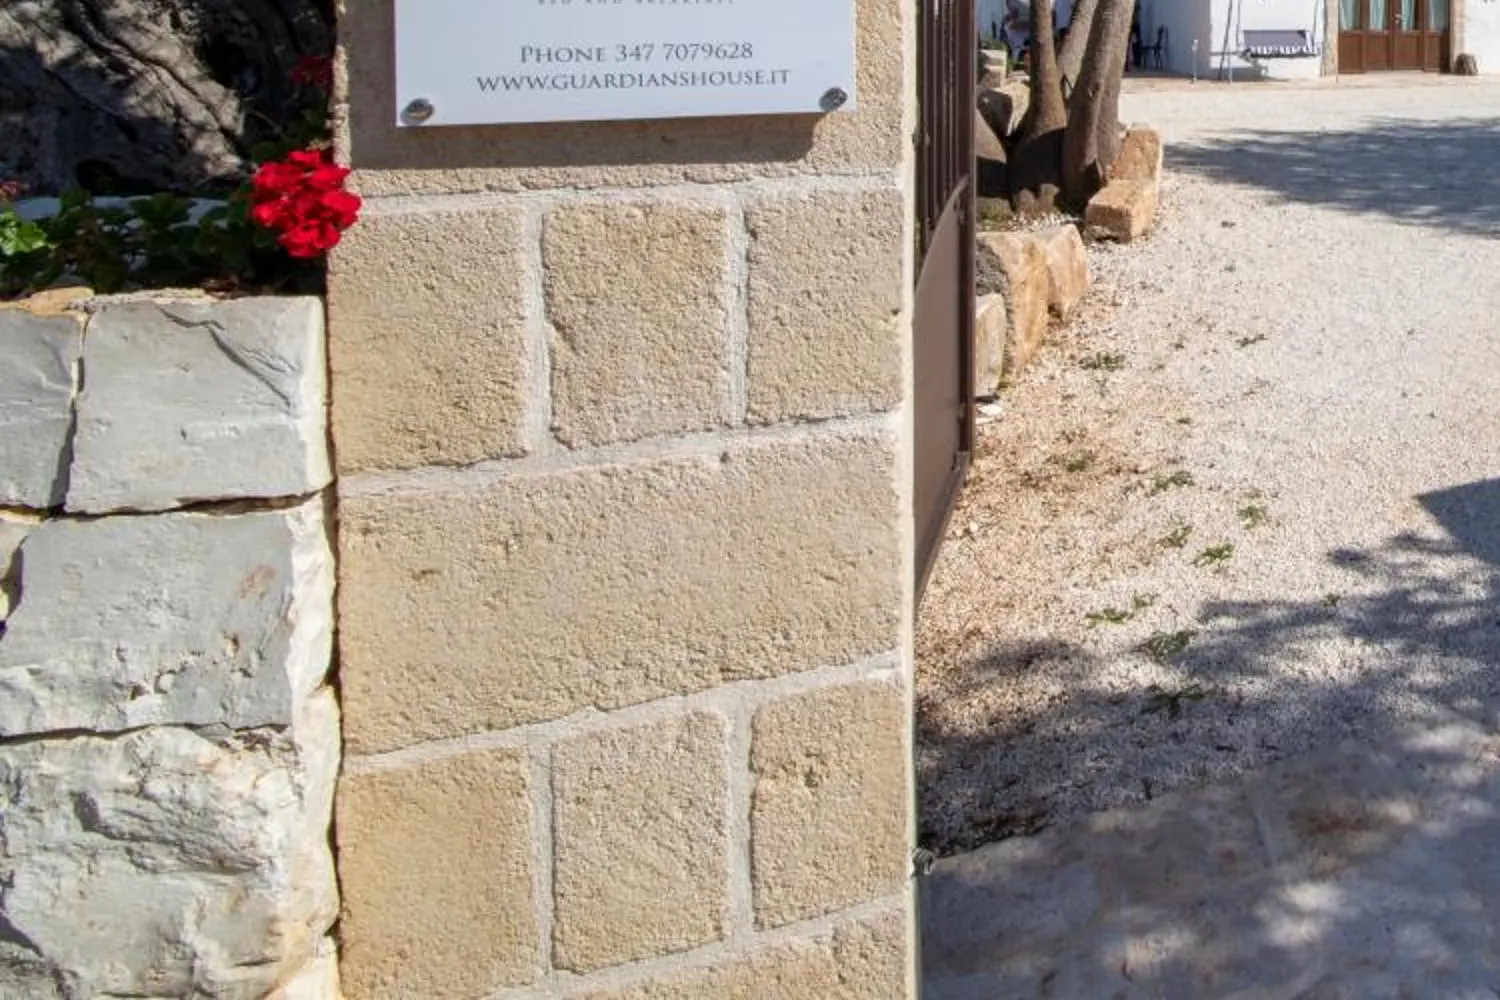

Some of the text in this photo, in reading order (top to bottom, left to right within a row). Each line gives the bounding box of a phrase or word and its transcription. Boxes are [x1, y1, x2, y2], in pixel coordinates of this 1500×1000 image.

[520, 42, 753, 64] PHONE 347 7079628
[476, 69, 791, 93] WWW.GUARDIANSHOUSE.IT
